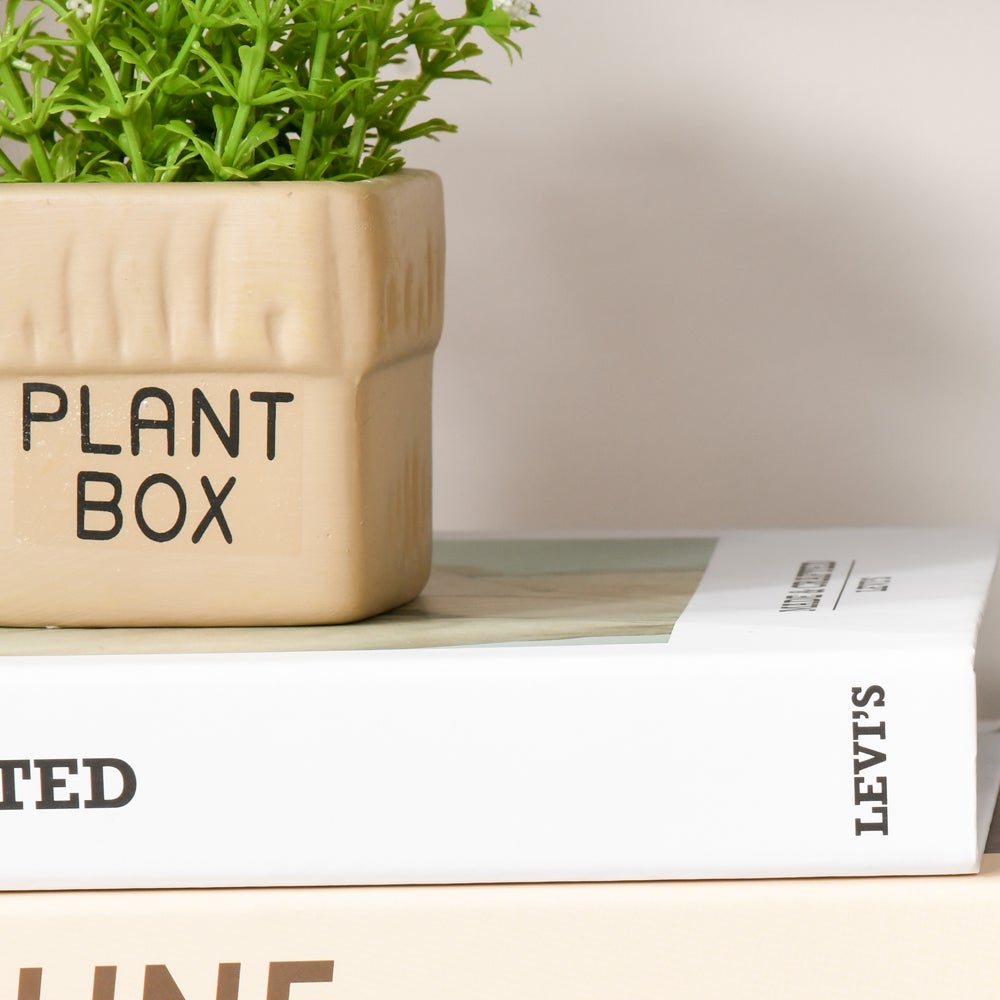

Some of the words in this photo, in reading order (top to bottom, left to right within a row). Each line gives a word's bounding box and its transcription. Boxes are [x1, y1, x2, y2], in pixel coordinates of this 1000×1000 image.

[23, 382, 294, 461] PLANT
[77, 471, 236, 544] BOX
[0, 757, 138, 810] TED
[851, 684, 889, 836] LEVI'S
